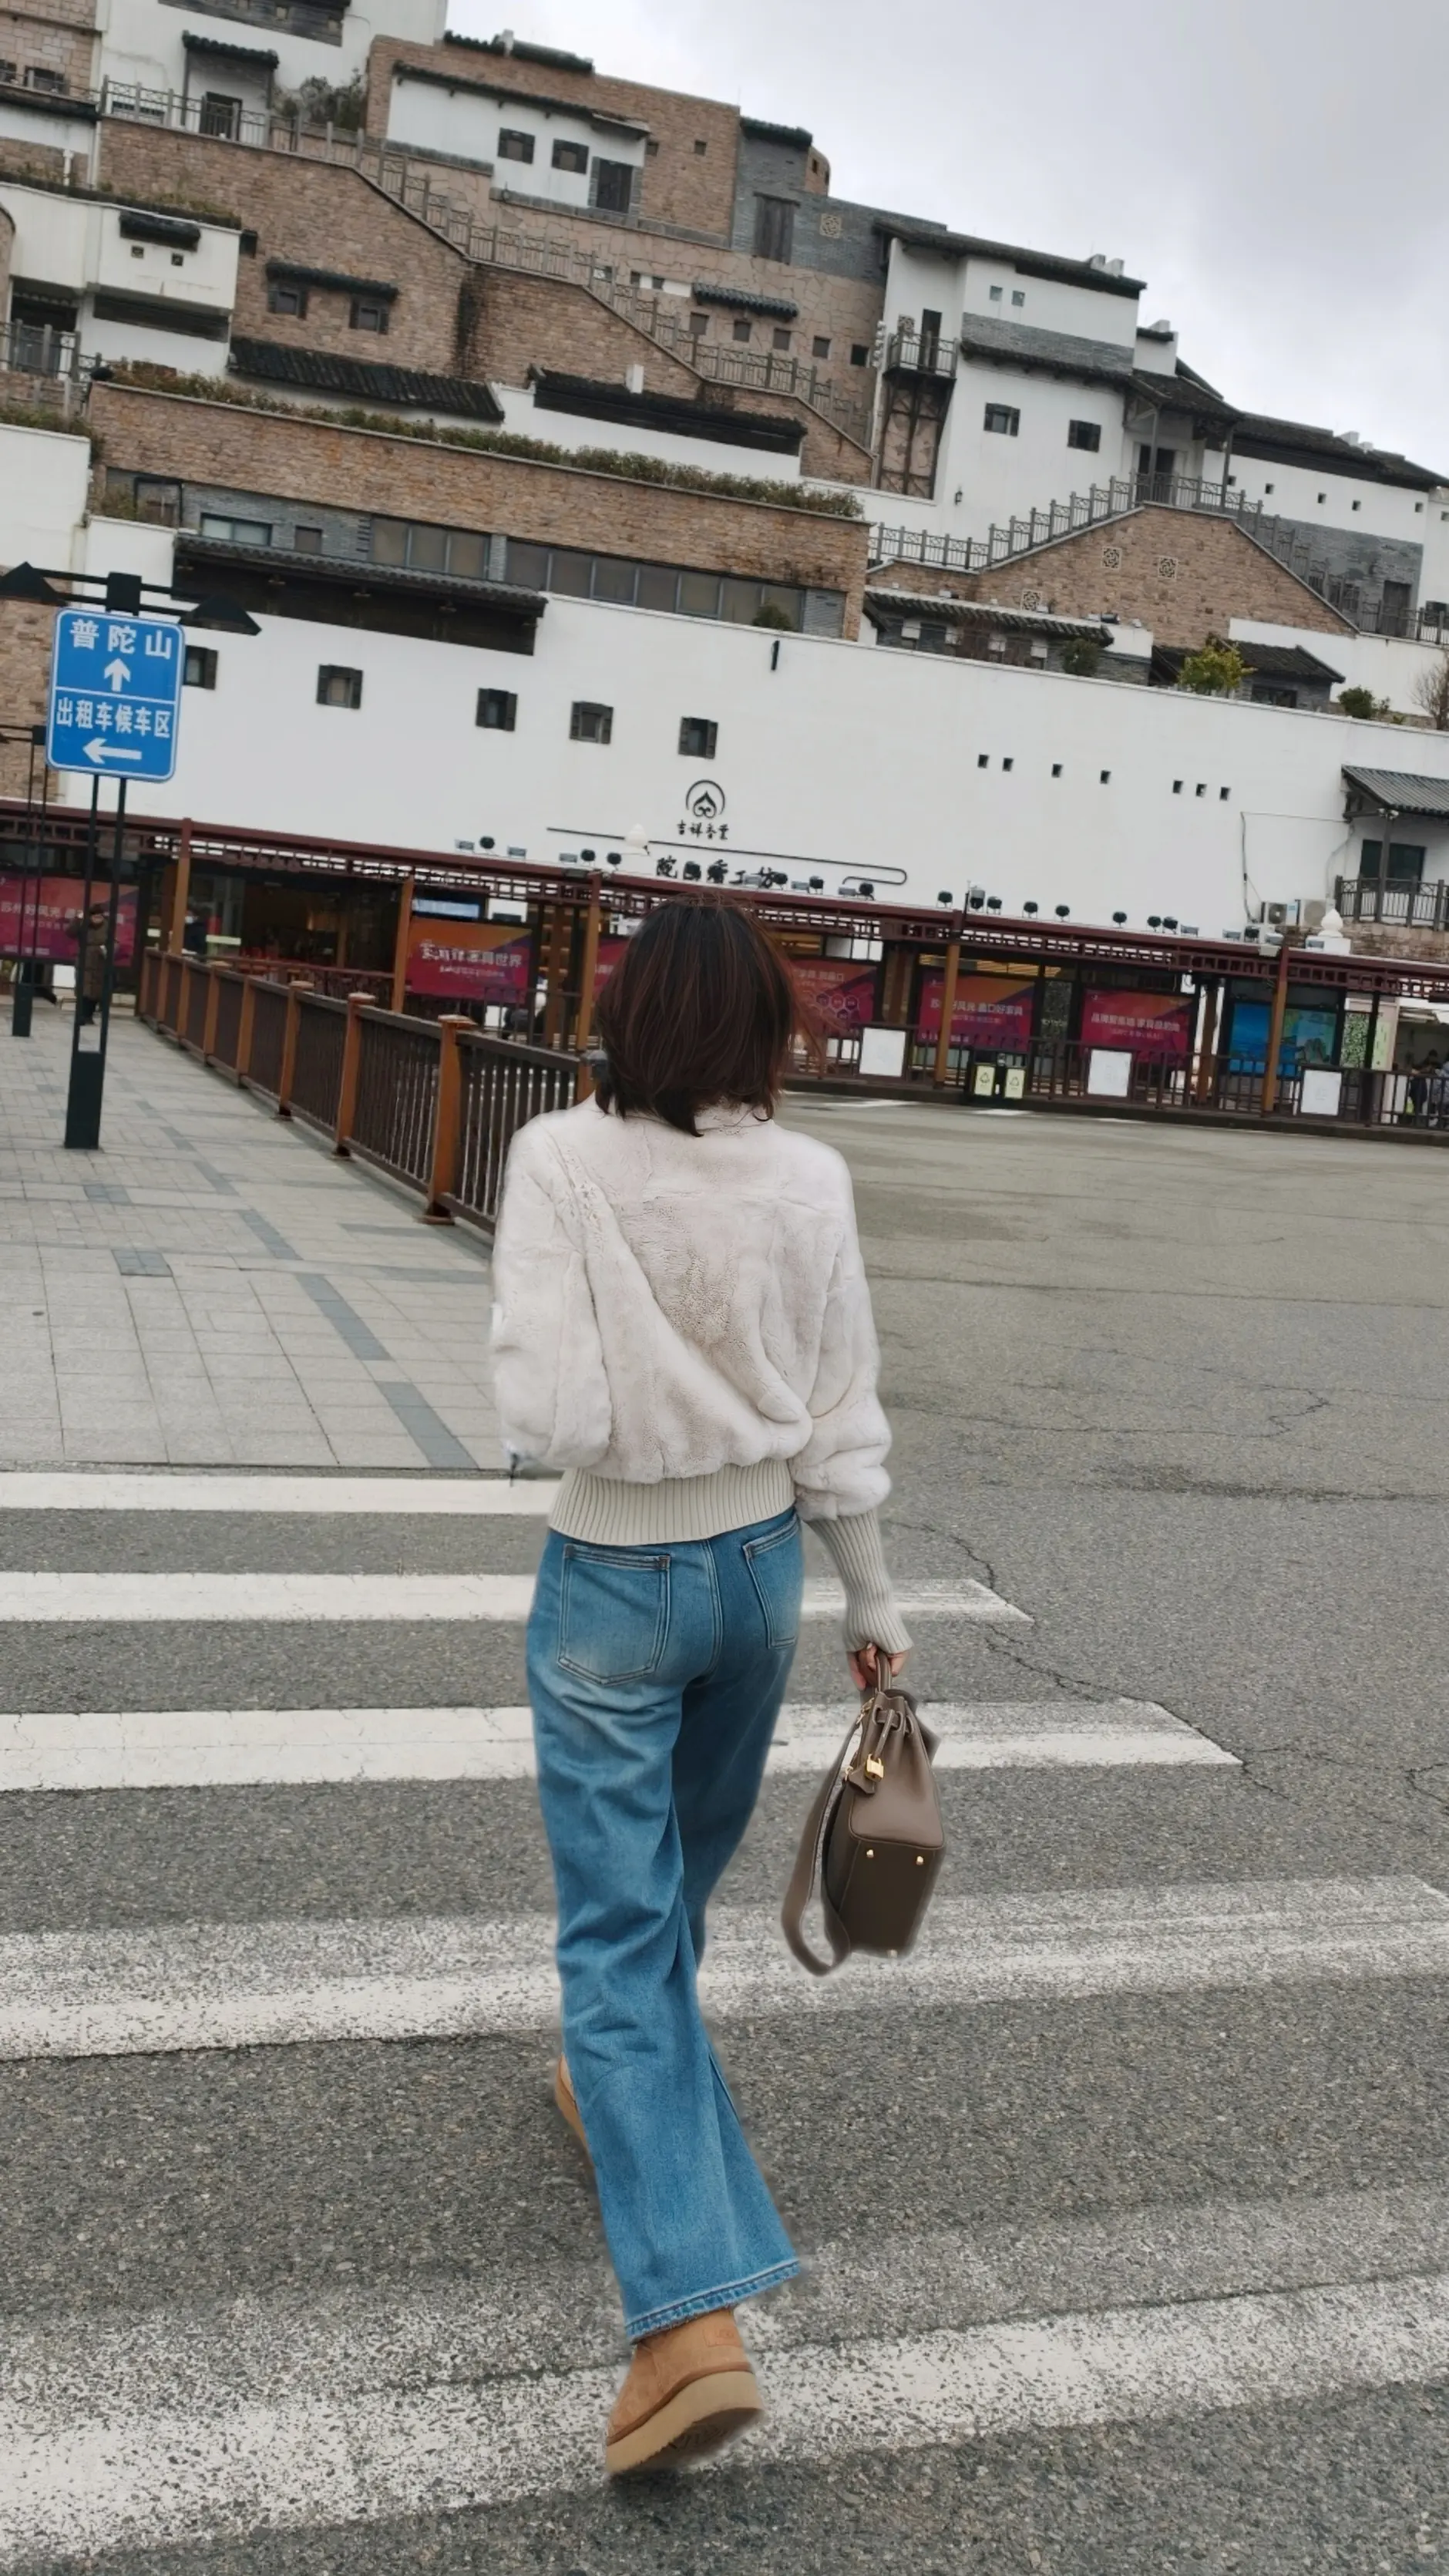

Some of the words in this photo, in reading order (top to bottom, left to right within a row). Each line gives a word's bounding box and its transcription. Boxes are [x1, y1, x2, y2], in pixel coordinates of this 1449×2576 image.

[69, 619, 172, 660] 普陀山
[56, 697, 171, 738] 出租车候车区
